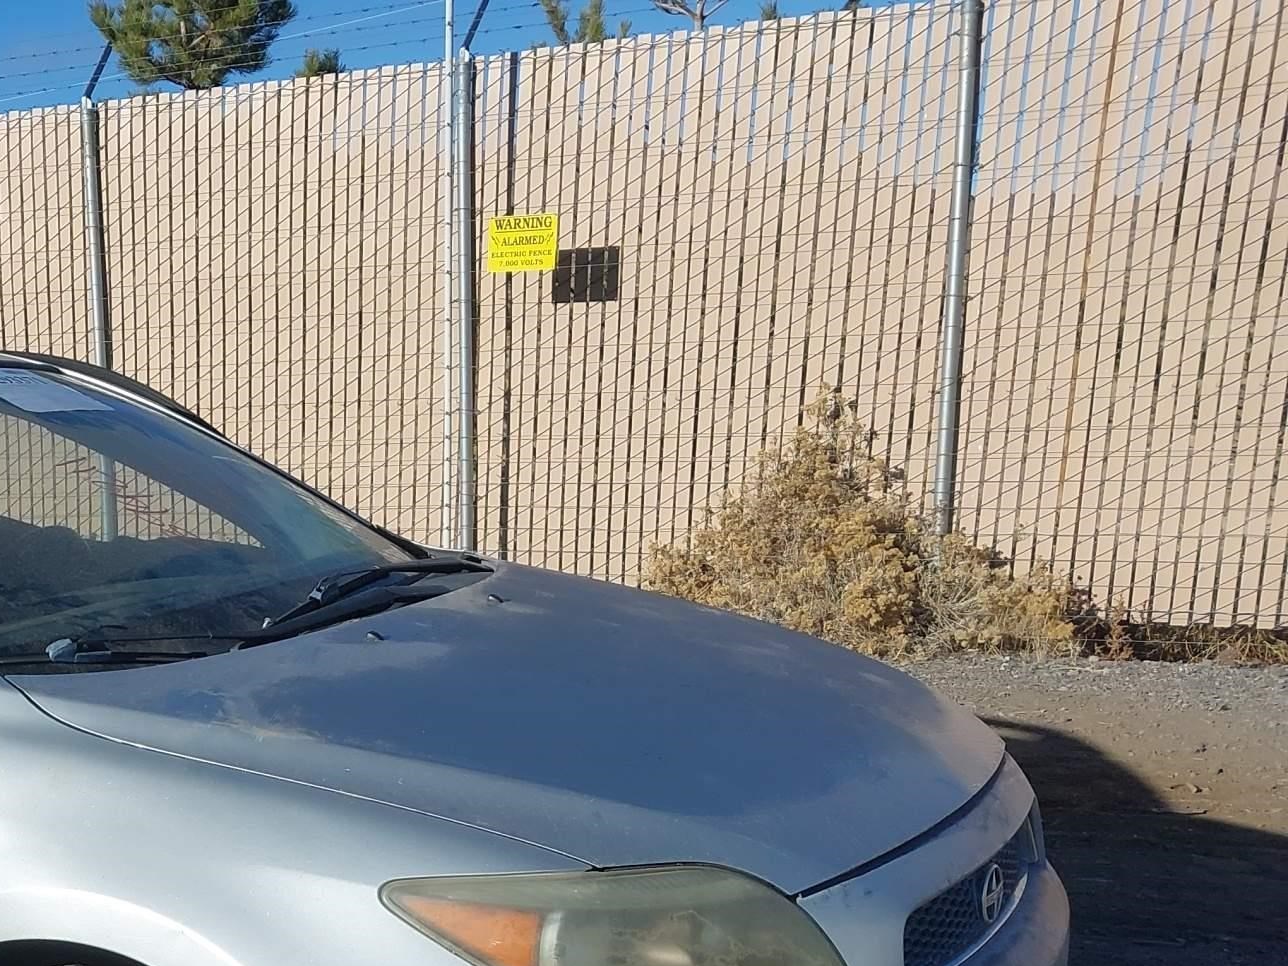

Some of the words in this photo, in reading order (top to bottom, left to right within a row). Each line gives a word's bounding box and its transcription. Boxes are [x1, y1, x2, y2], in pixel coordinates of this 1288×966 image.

[494, 216, 553, 231] WARNING
[500, 235, 545, 247] ALARMED
[491, 249, 527, 258] ELECTRIC
[528, 249, 553, 257] FENCE
[520, 258, 544, 266] VOLTS
